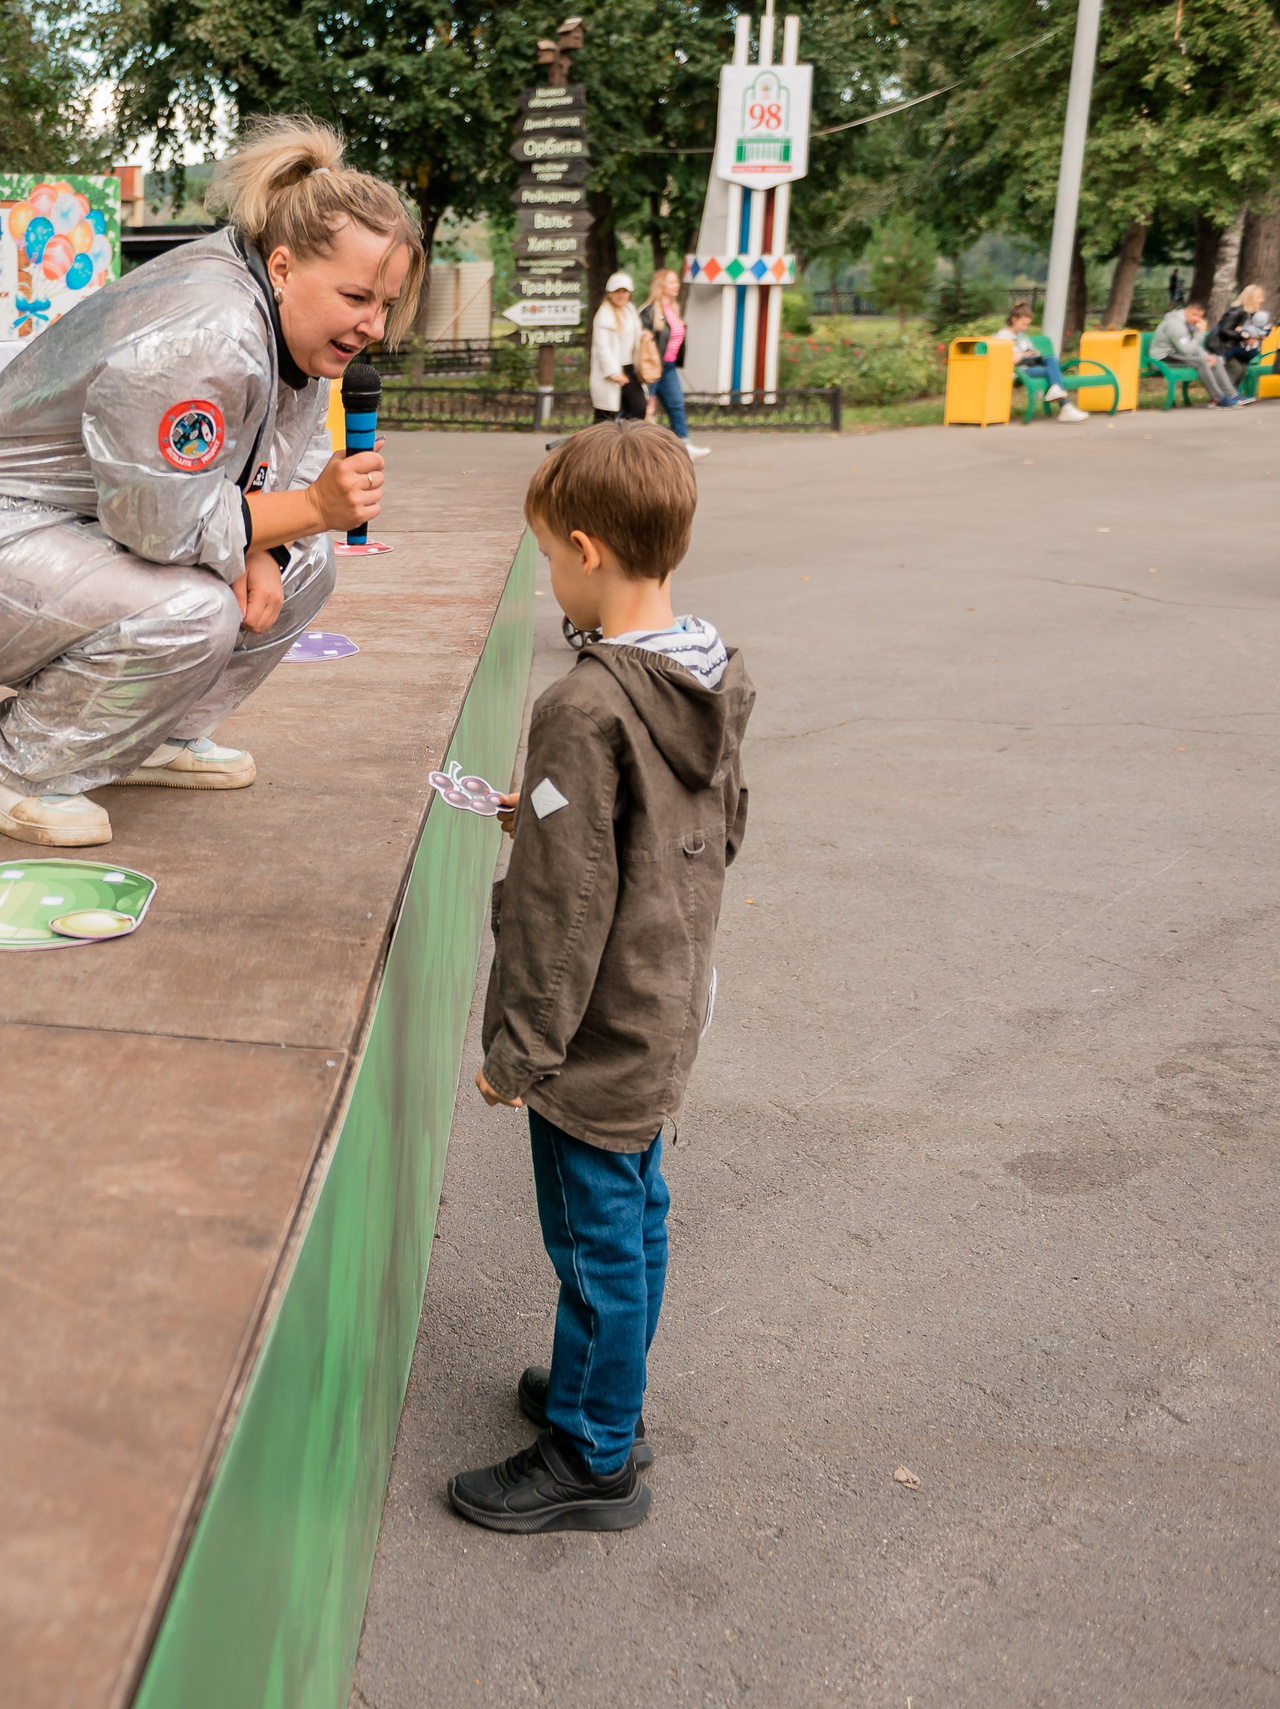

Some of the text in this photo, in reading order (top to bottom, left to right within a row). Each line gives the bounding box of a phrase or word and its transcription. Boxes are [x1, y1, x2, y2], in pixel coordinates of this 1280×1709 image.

[749, 103, 782, 130] 98
[523, 138, 582, 159] Орбита
[521, 189, 581, 205] Рейнджер
[534, 212, 573, 229] Вальс
[527, 237, 578, 252] Хип-хоп
[519, 278, 580, 297] Траффик
[518, 329, 572, 346] Туалет
